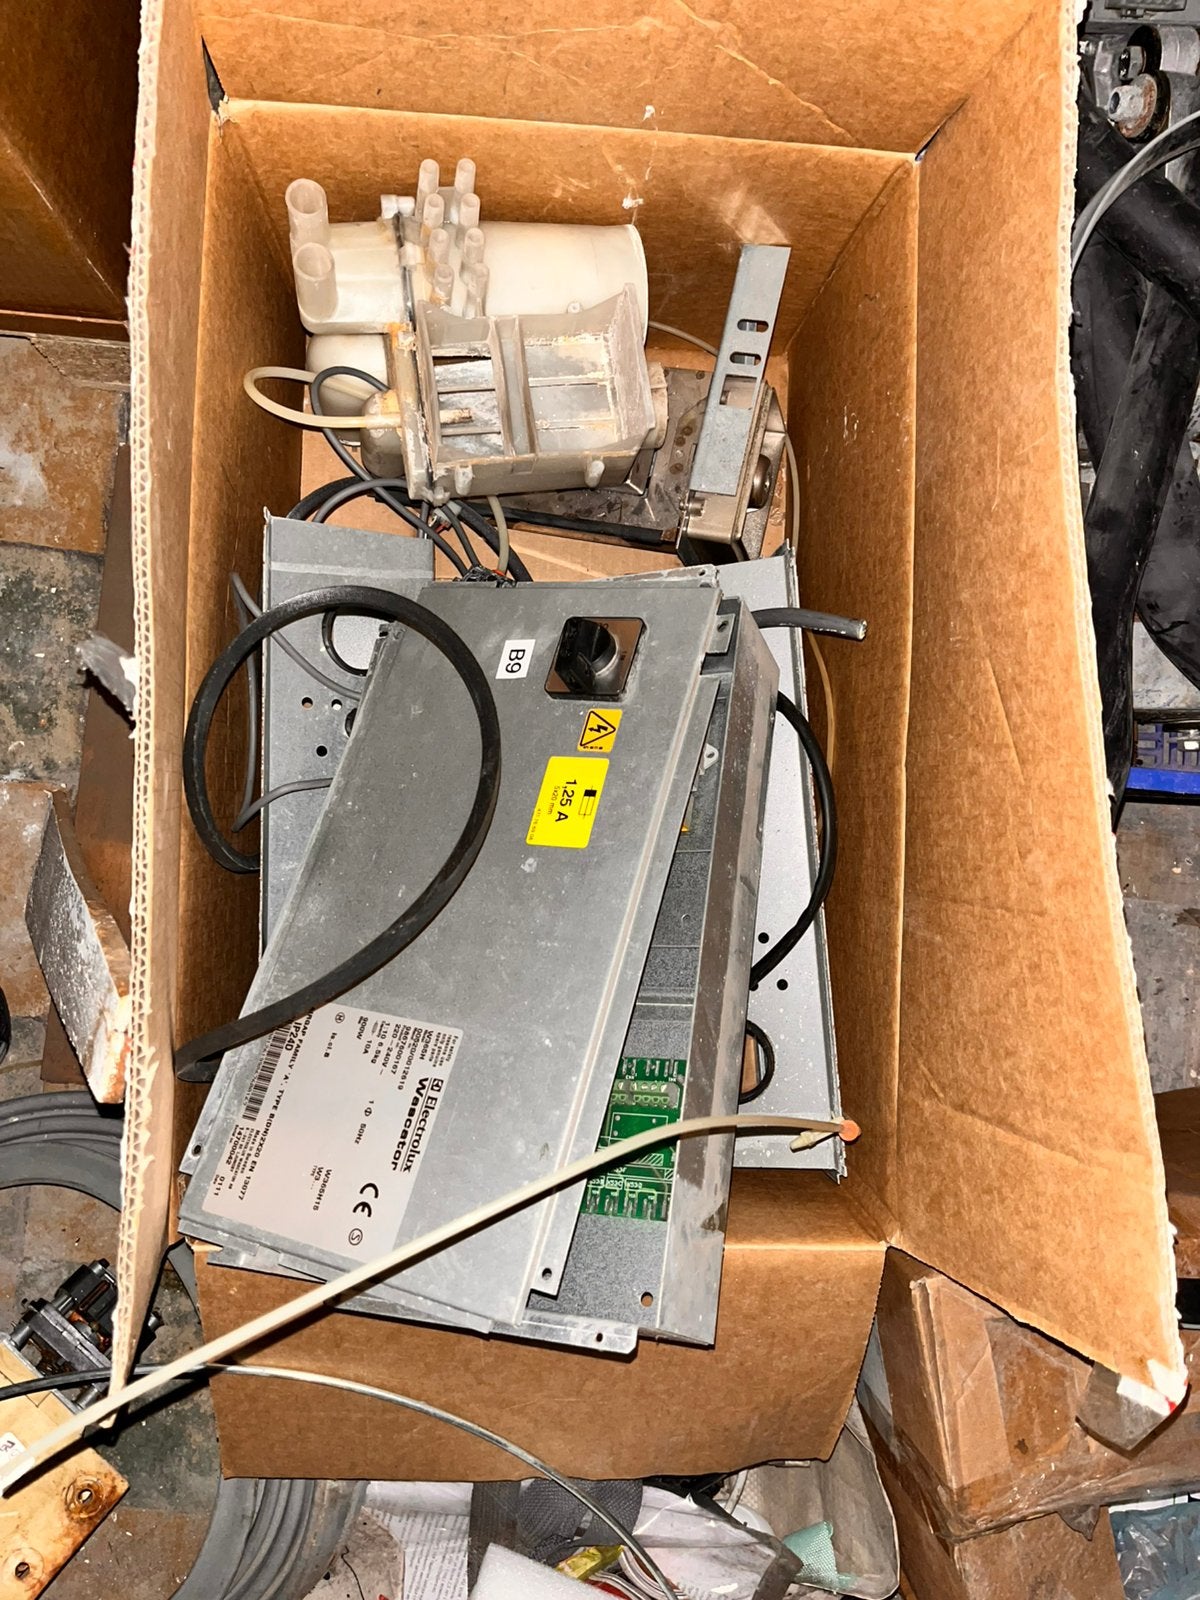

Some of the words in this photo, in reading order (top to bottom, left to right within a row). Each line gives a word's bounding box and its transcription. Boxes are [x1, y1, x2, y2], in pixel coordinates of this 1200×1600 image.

[505, 648, 526, 674] B9
[559, 779, 578, 807] 1,25
[547, 802, 555, 815] mm
[554, 810, 569, 823] A
[284, 1020, 303, 1052] IP24D
[356, 1016, 369, 1040] 900W
[391, 1023, 402, 1039] 220
[287, 1038, 304, 1070] FAMILY
[362, 1040, 373, 1055] 10A
[370, 1041, 384, 1065] 6.5kg
[381, 1046, 394, 1068] 240V
[390, 1025, 412, 1075] 9867600167
[419, 1030, 434, 1061] W365H
[397, 1027, 424, 1091] 00520/0012619
[271, 1089, 285, 1111] TYPE
[354, 1123, 367, 1145] 50Hz
[391, 1077, 429, 1171] Wascator
[402, 1095, 439, 1173] Electrolux
[225, 1125, 245, 1166] 14700042
[251, 1129, 261, 1145] Made
[240, 1152, 252, 1174] Sweden
[248, 1160, 258, 1173] EN
[213, 1175, 226, 1196] 0111
[238, 1176, 252, 1201] 13077
[312, 1169, 333, 1211] W365H15
